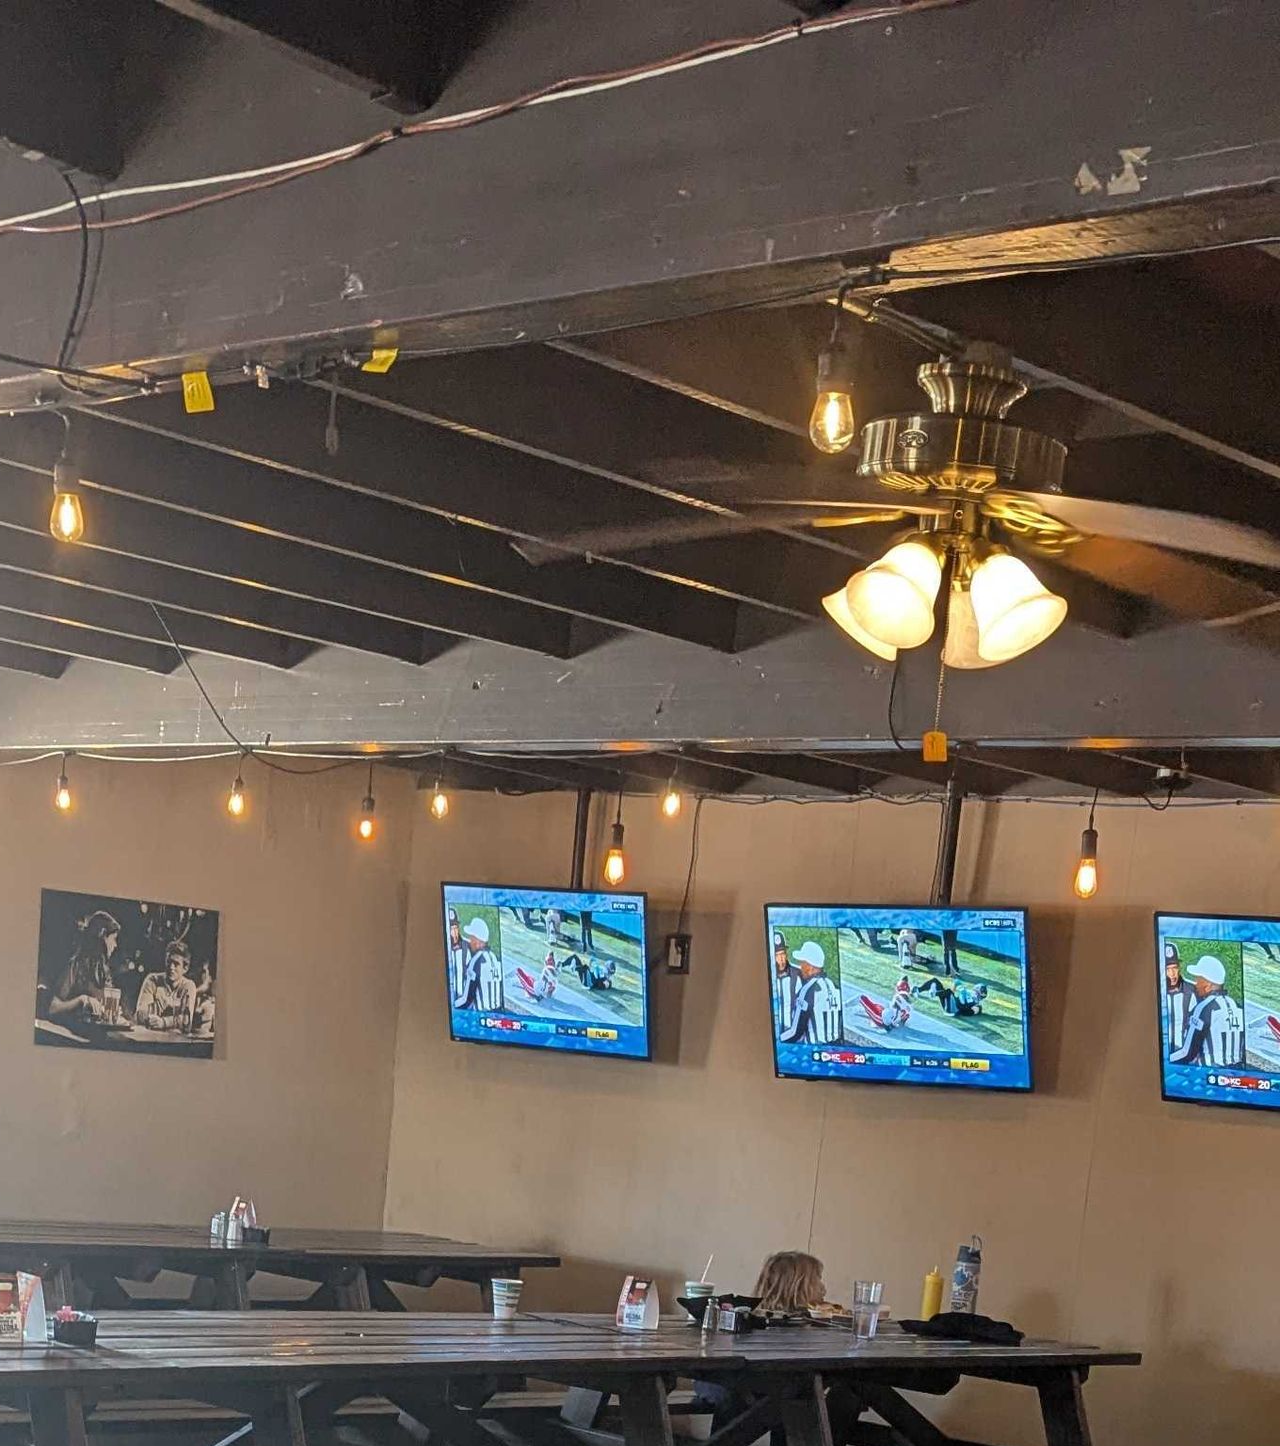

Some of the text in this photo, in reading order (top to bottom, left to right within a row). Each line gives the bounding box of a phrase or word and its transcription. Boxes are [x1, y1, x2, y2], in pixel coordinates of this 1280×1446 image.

[1226, 1017, 1240, 1030] 14
[854, 1054, 865, 1064] 20
[961, 1061, 979, 1069] FLAG
[1258, 1080, 1270, 1090] 20
